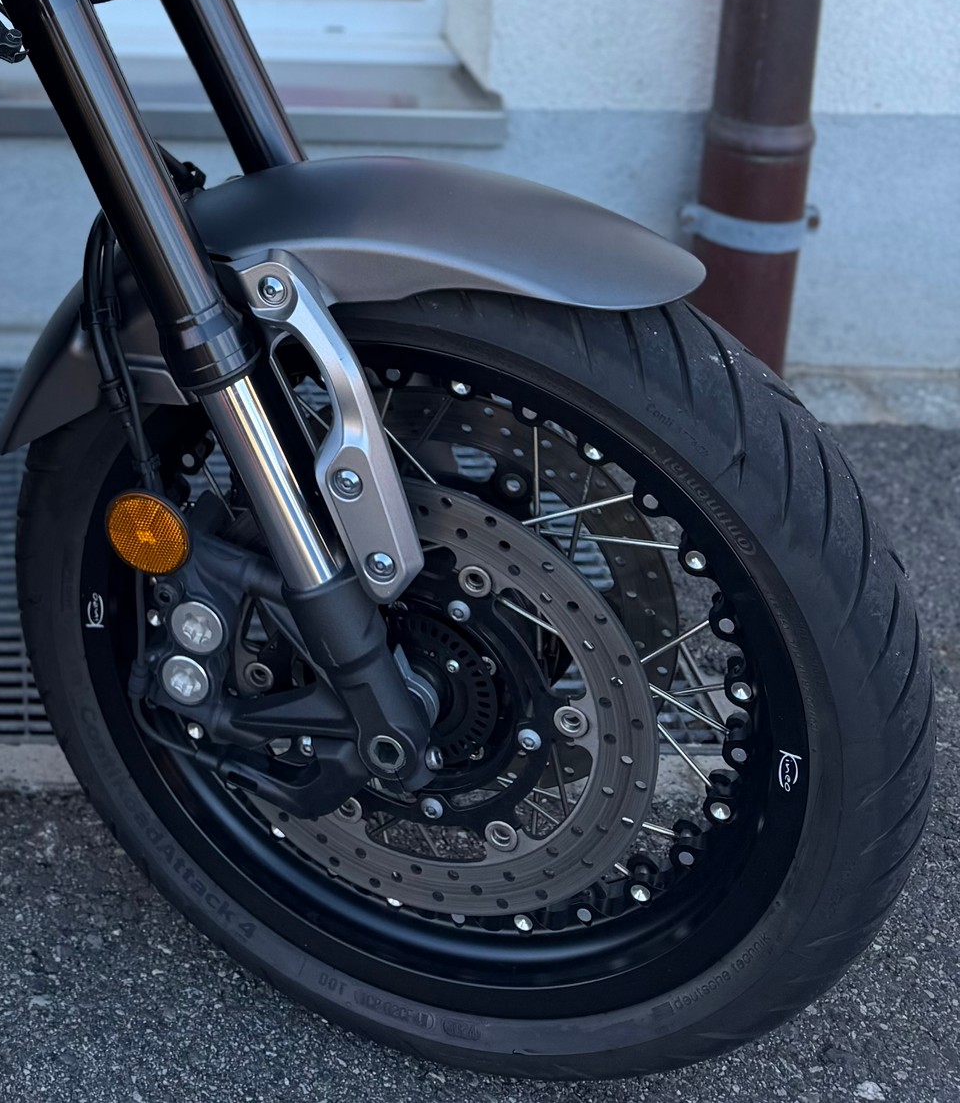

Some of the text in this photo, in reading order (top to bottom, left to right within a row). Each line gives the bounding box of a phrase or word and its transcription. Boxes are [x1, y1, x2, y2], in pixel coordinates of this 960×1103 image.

[778, 749, 803, 793] Kineo
[238, 921, 258, 941] 4
[318, 972, 349, 995] DOT
[673, 932, 770, 1010] deutsche technik
